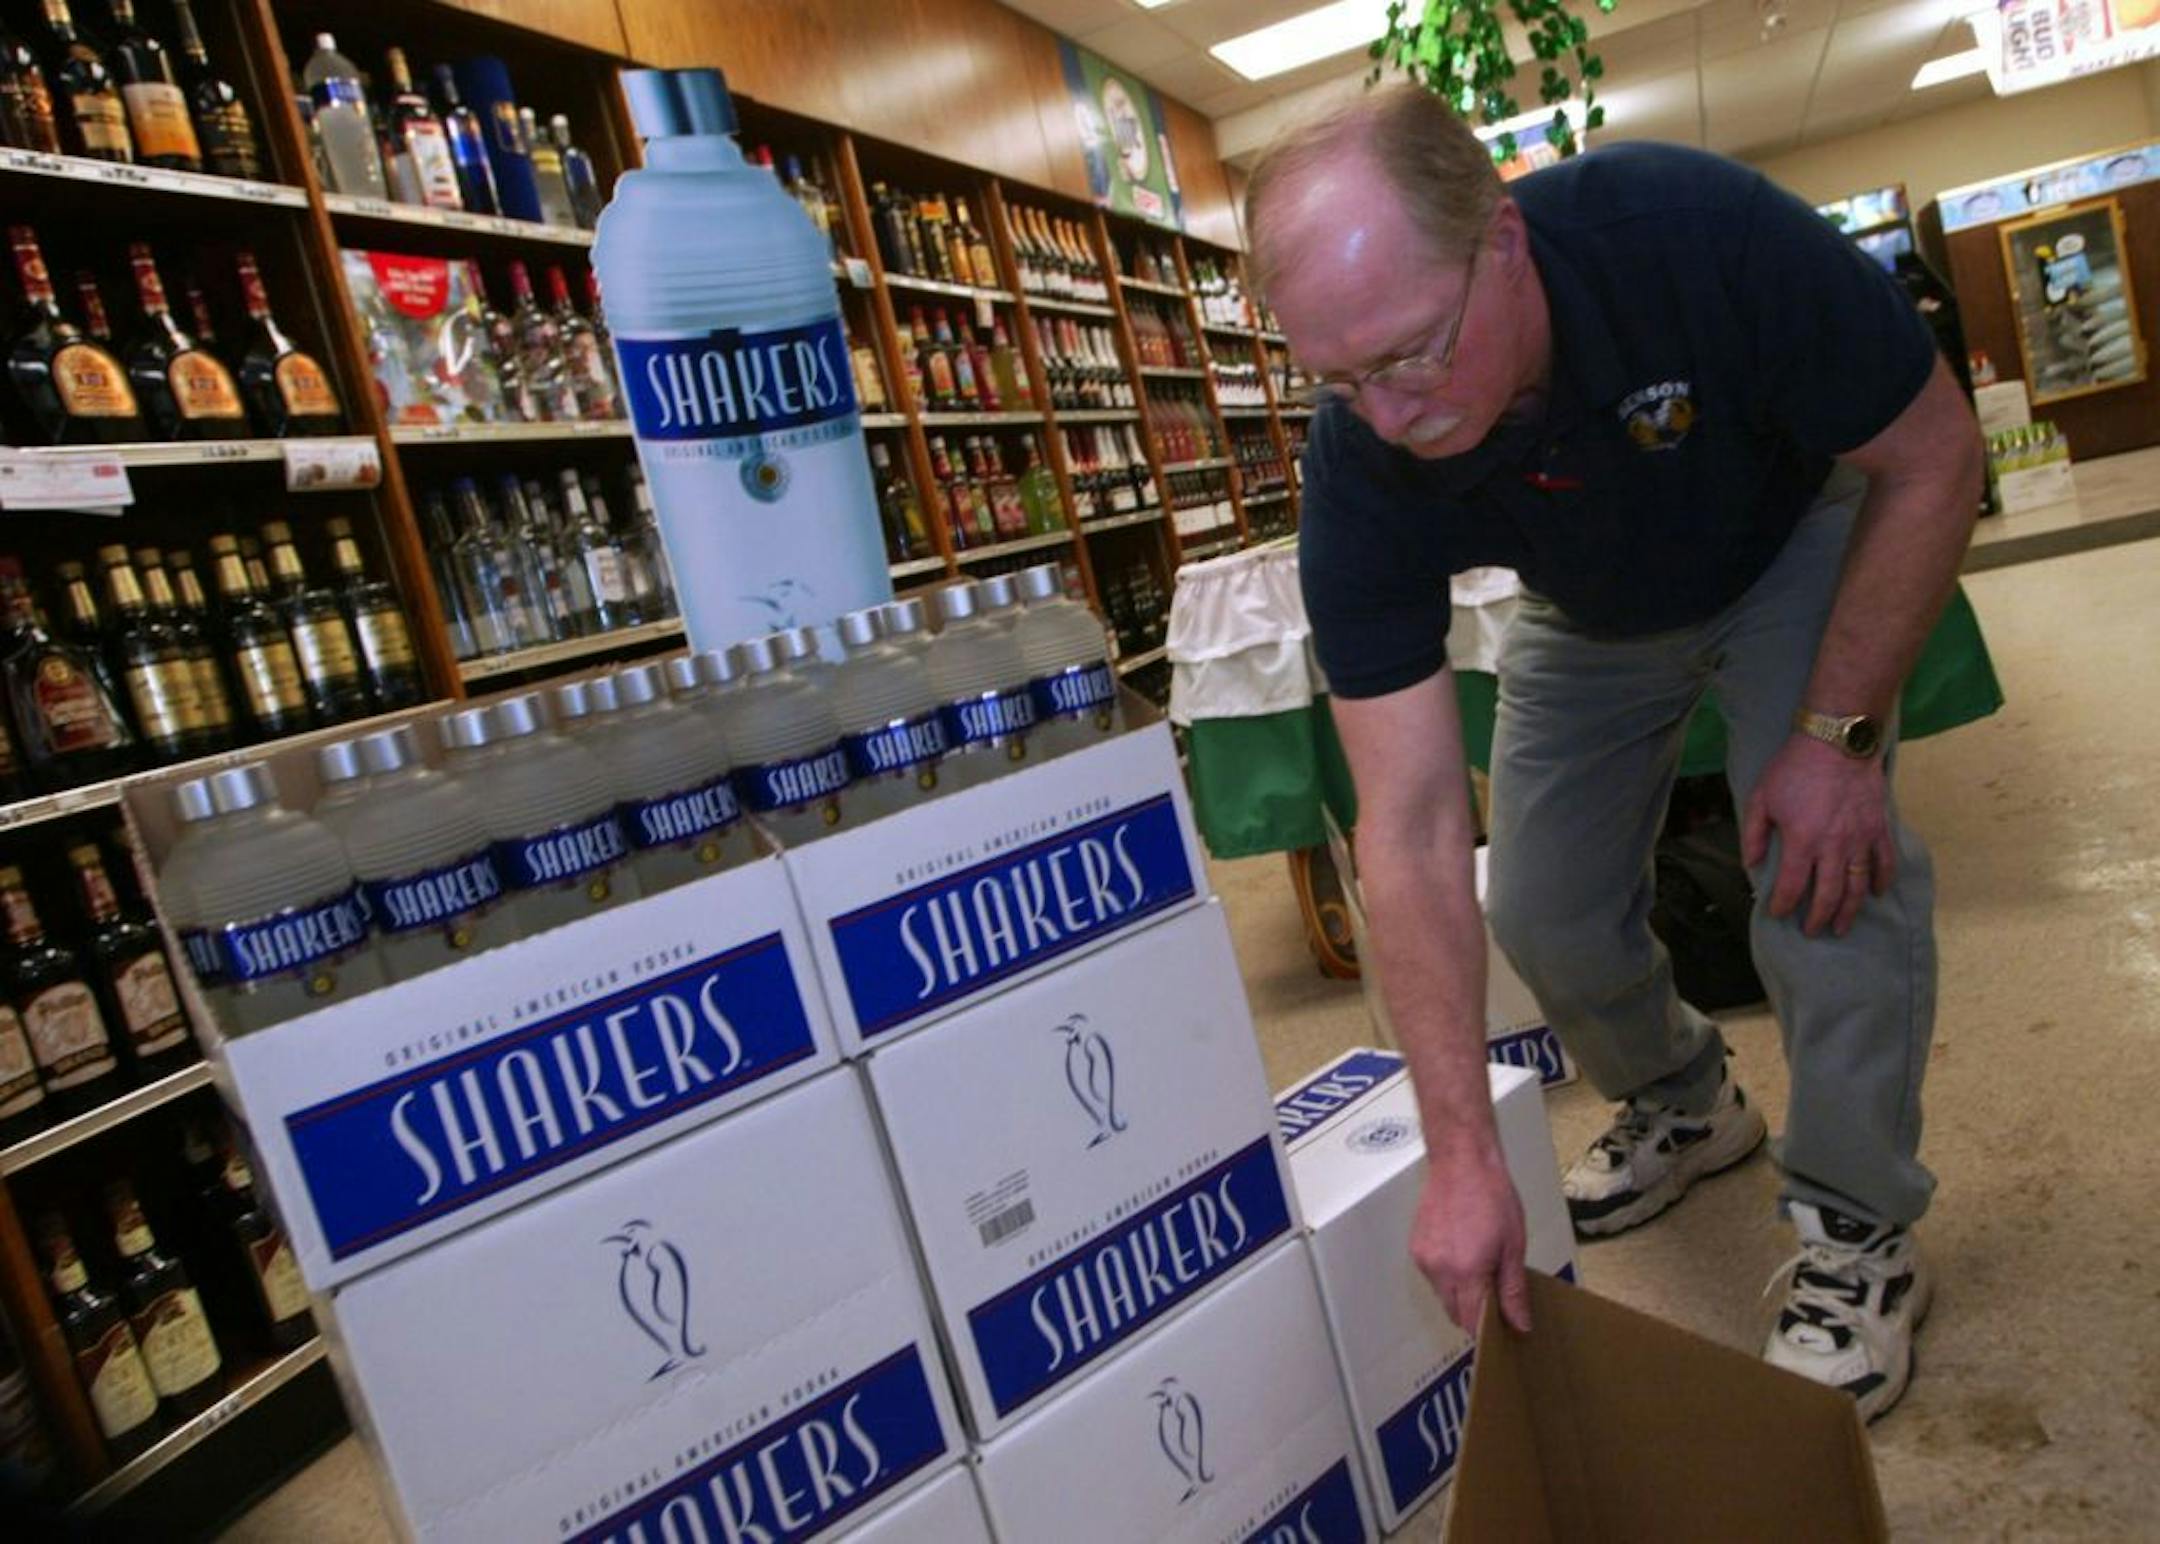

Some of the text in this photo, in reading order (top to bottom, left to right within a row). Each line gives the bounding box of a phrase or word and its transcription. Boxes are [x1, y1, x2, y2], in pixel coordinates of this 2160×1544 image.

[2031, 9, 2055, 60] BUD
[647, 336, 840, 429] SHAKERS
[895, 850, 974, 884] ORIGINAL
[984, 814, 1056, 852] AMERICAN
[900, 823, 1145, 1000] SHAKERS
[384, 942, 697, 1068] ORIGINAL AMERICAN VODKA
[390, 974, 743, 1206] SHAKERS
[1030, 1172, 1246, 1373] SHAKERS
[559, 1367, 840, 1533] ORIGINAL AMERICAN VODKA
